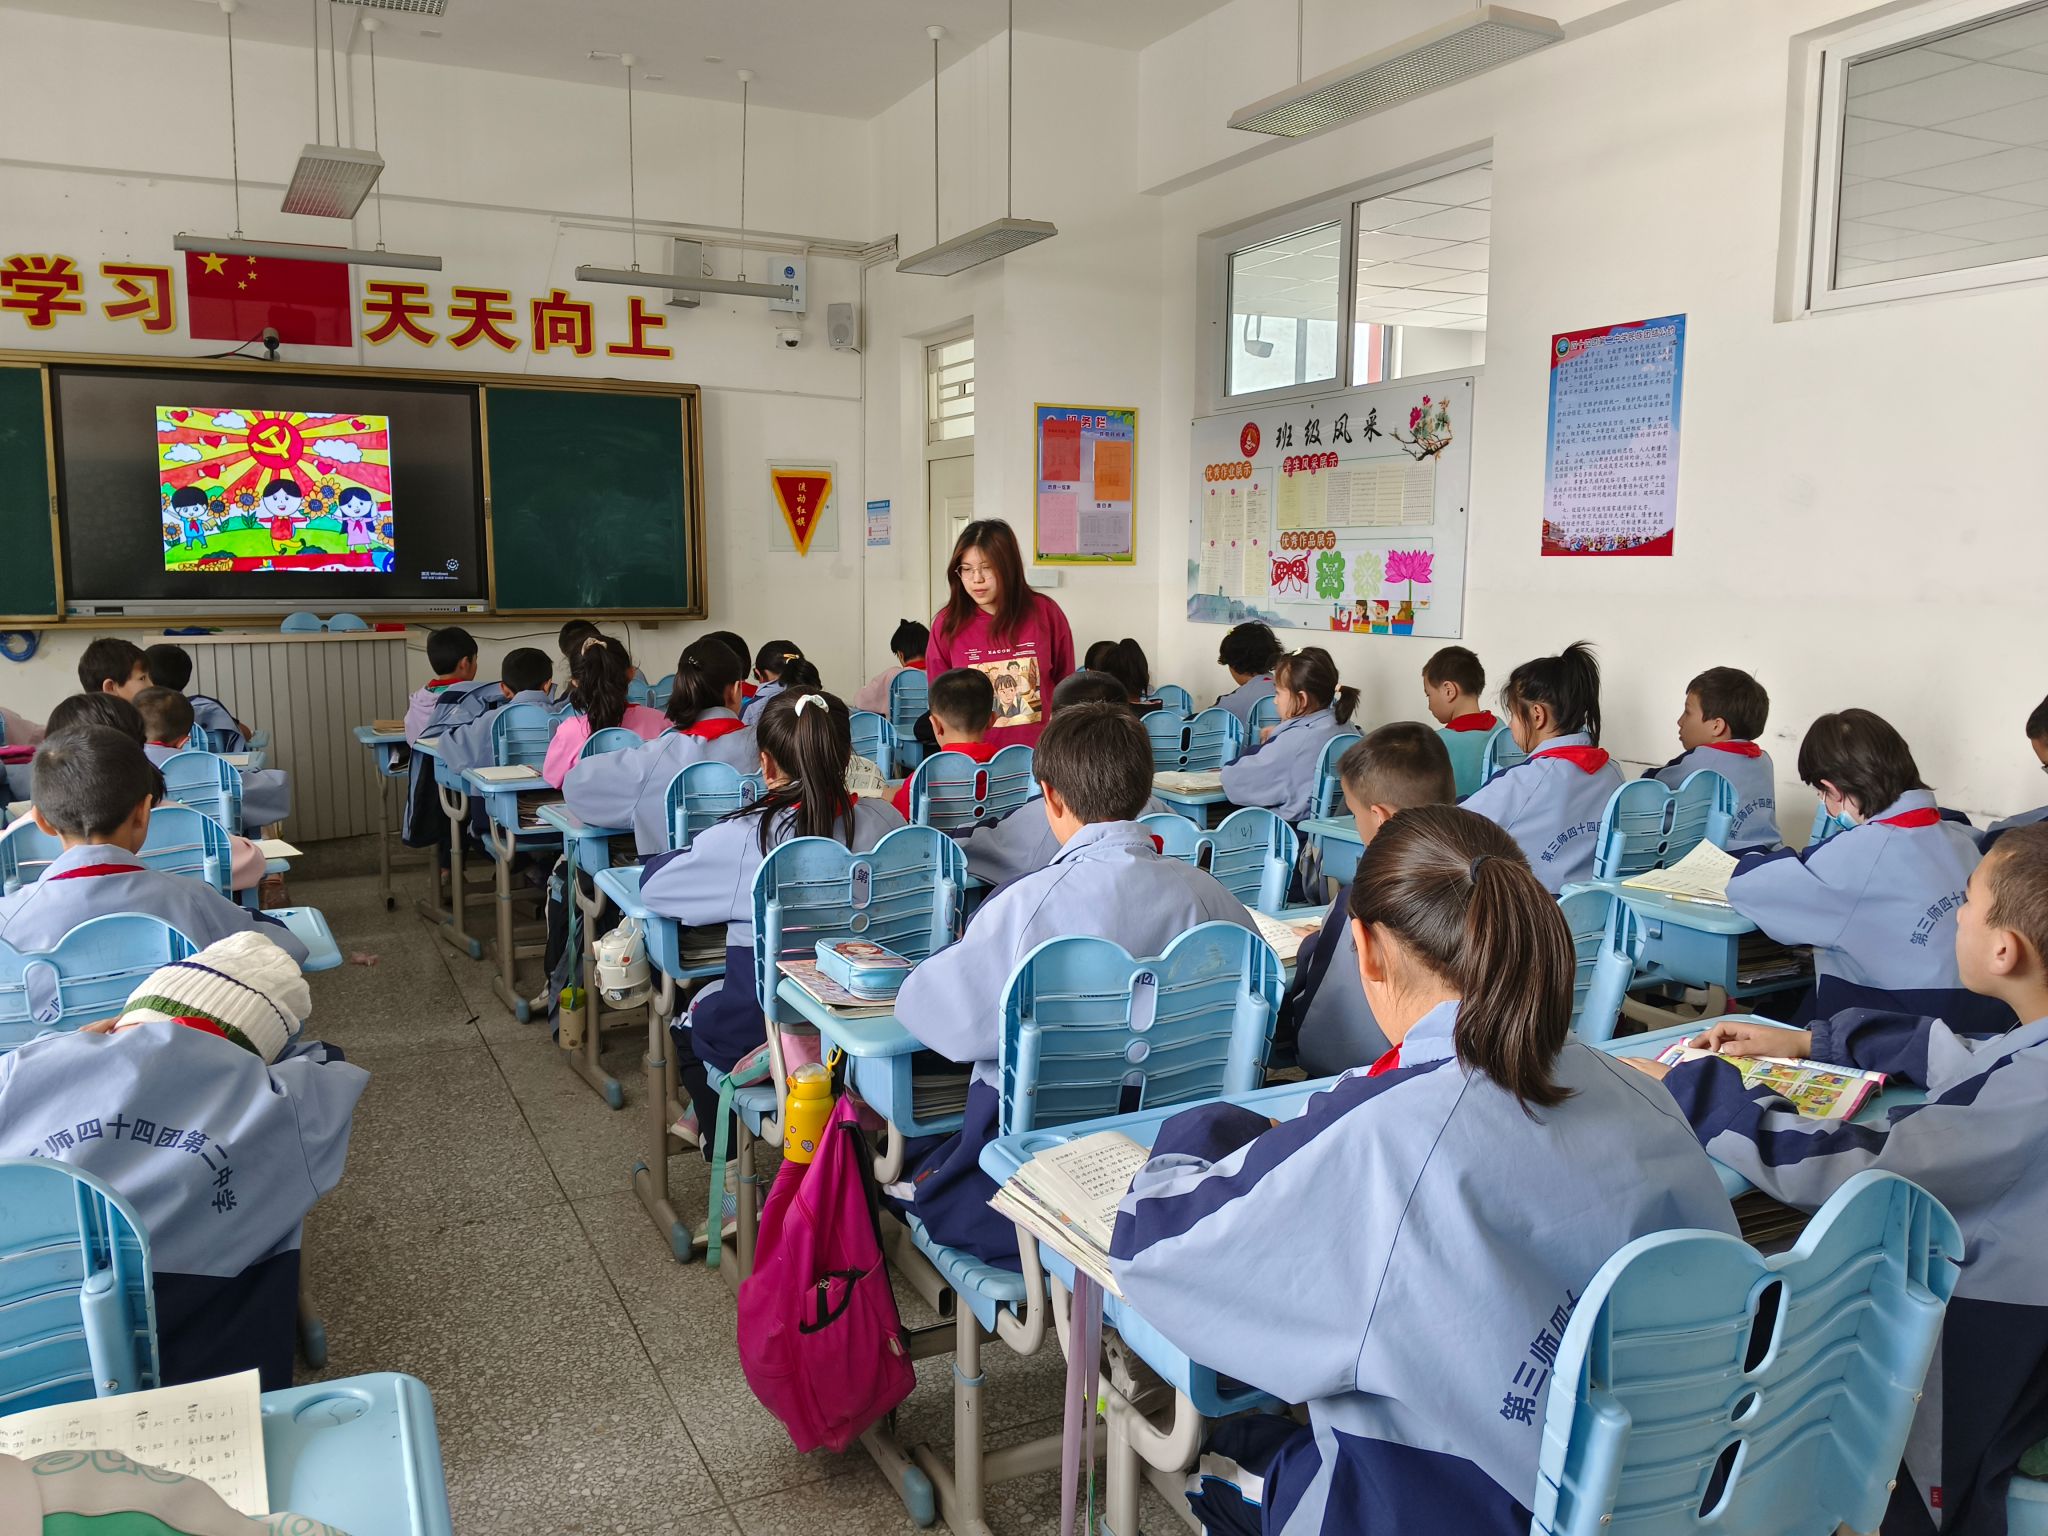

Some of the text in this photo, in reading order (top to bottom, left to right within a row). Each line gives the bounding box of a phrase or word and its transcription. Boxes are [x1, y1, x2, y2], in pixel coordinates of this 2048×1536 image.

[0, 254, 674, 361] 学习 天天向上
[1275, 407, 1382, 450] 班级风采
[1283, 452, 1338, 473] 学生风采展示
[1280, 531, 1337, 550] 优秀作品展示
